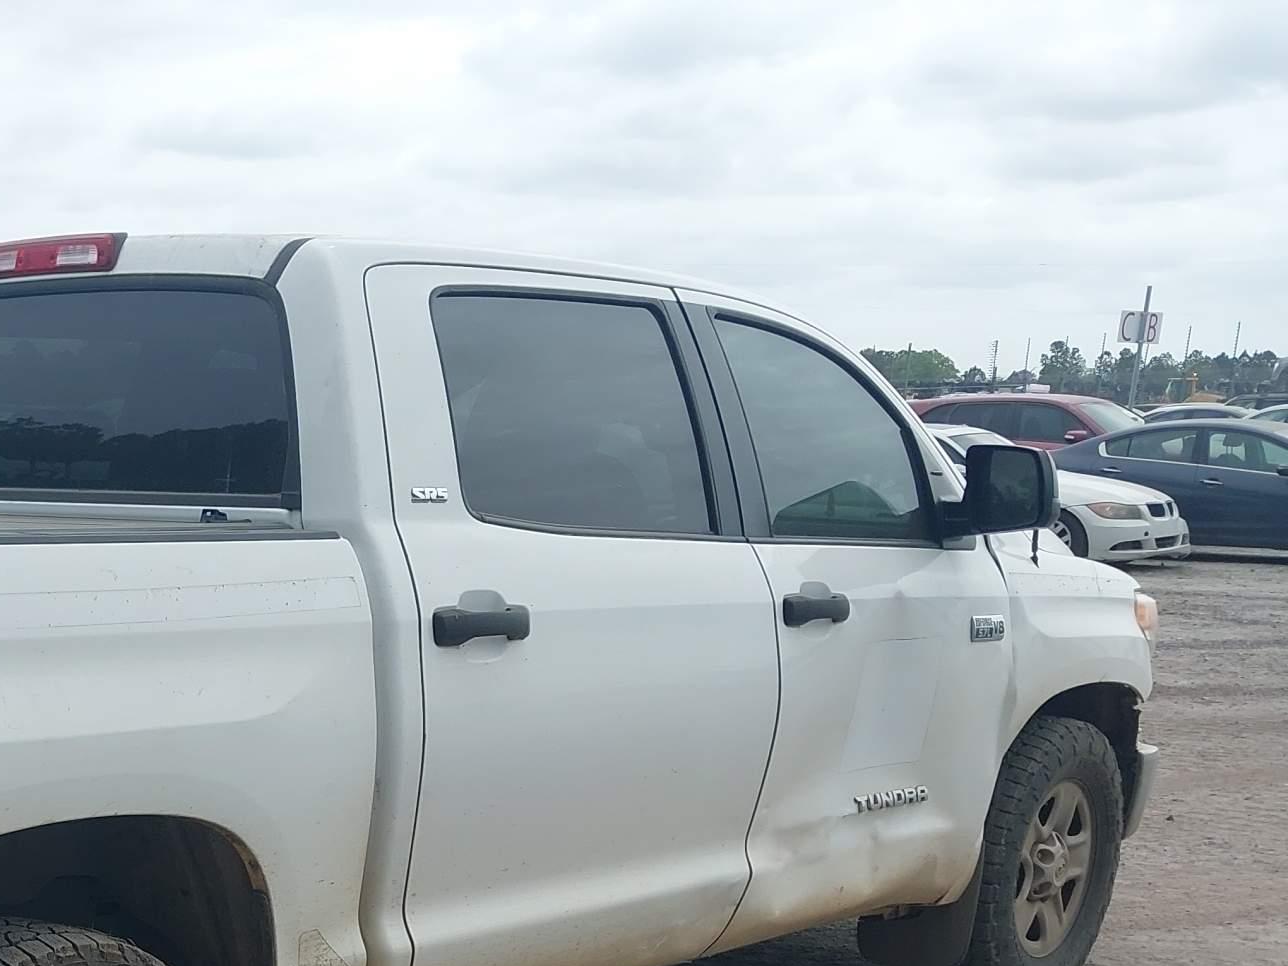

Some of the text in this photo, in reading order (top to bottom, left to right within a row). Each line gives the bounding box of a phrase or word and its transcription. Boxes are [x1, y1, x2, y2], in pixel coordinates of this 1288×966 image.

[1122, 312, 1158, 342] C B
[411, 487, 448, 503] SR5
[854, 785, 929, 813] TUNDRA
